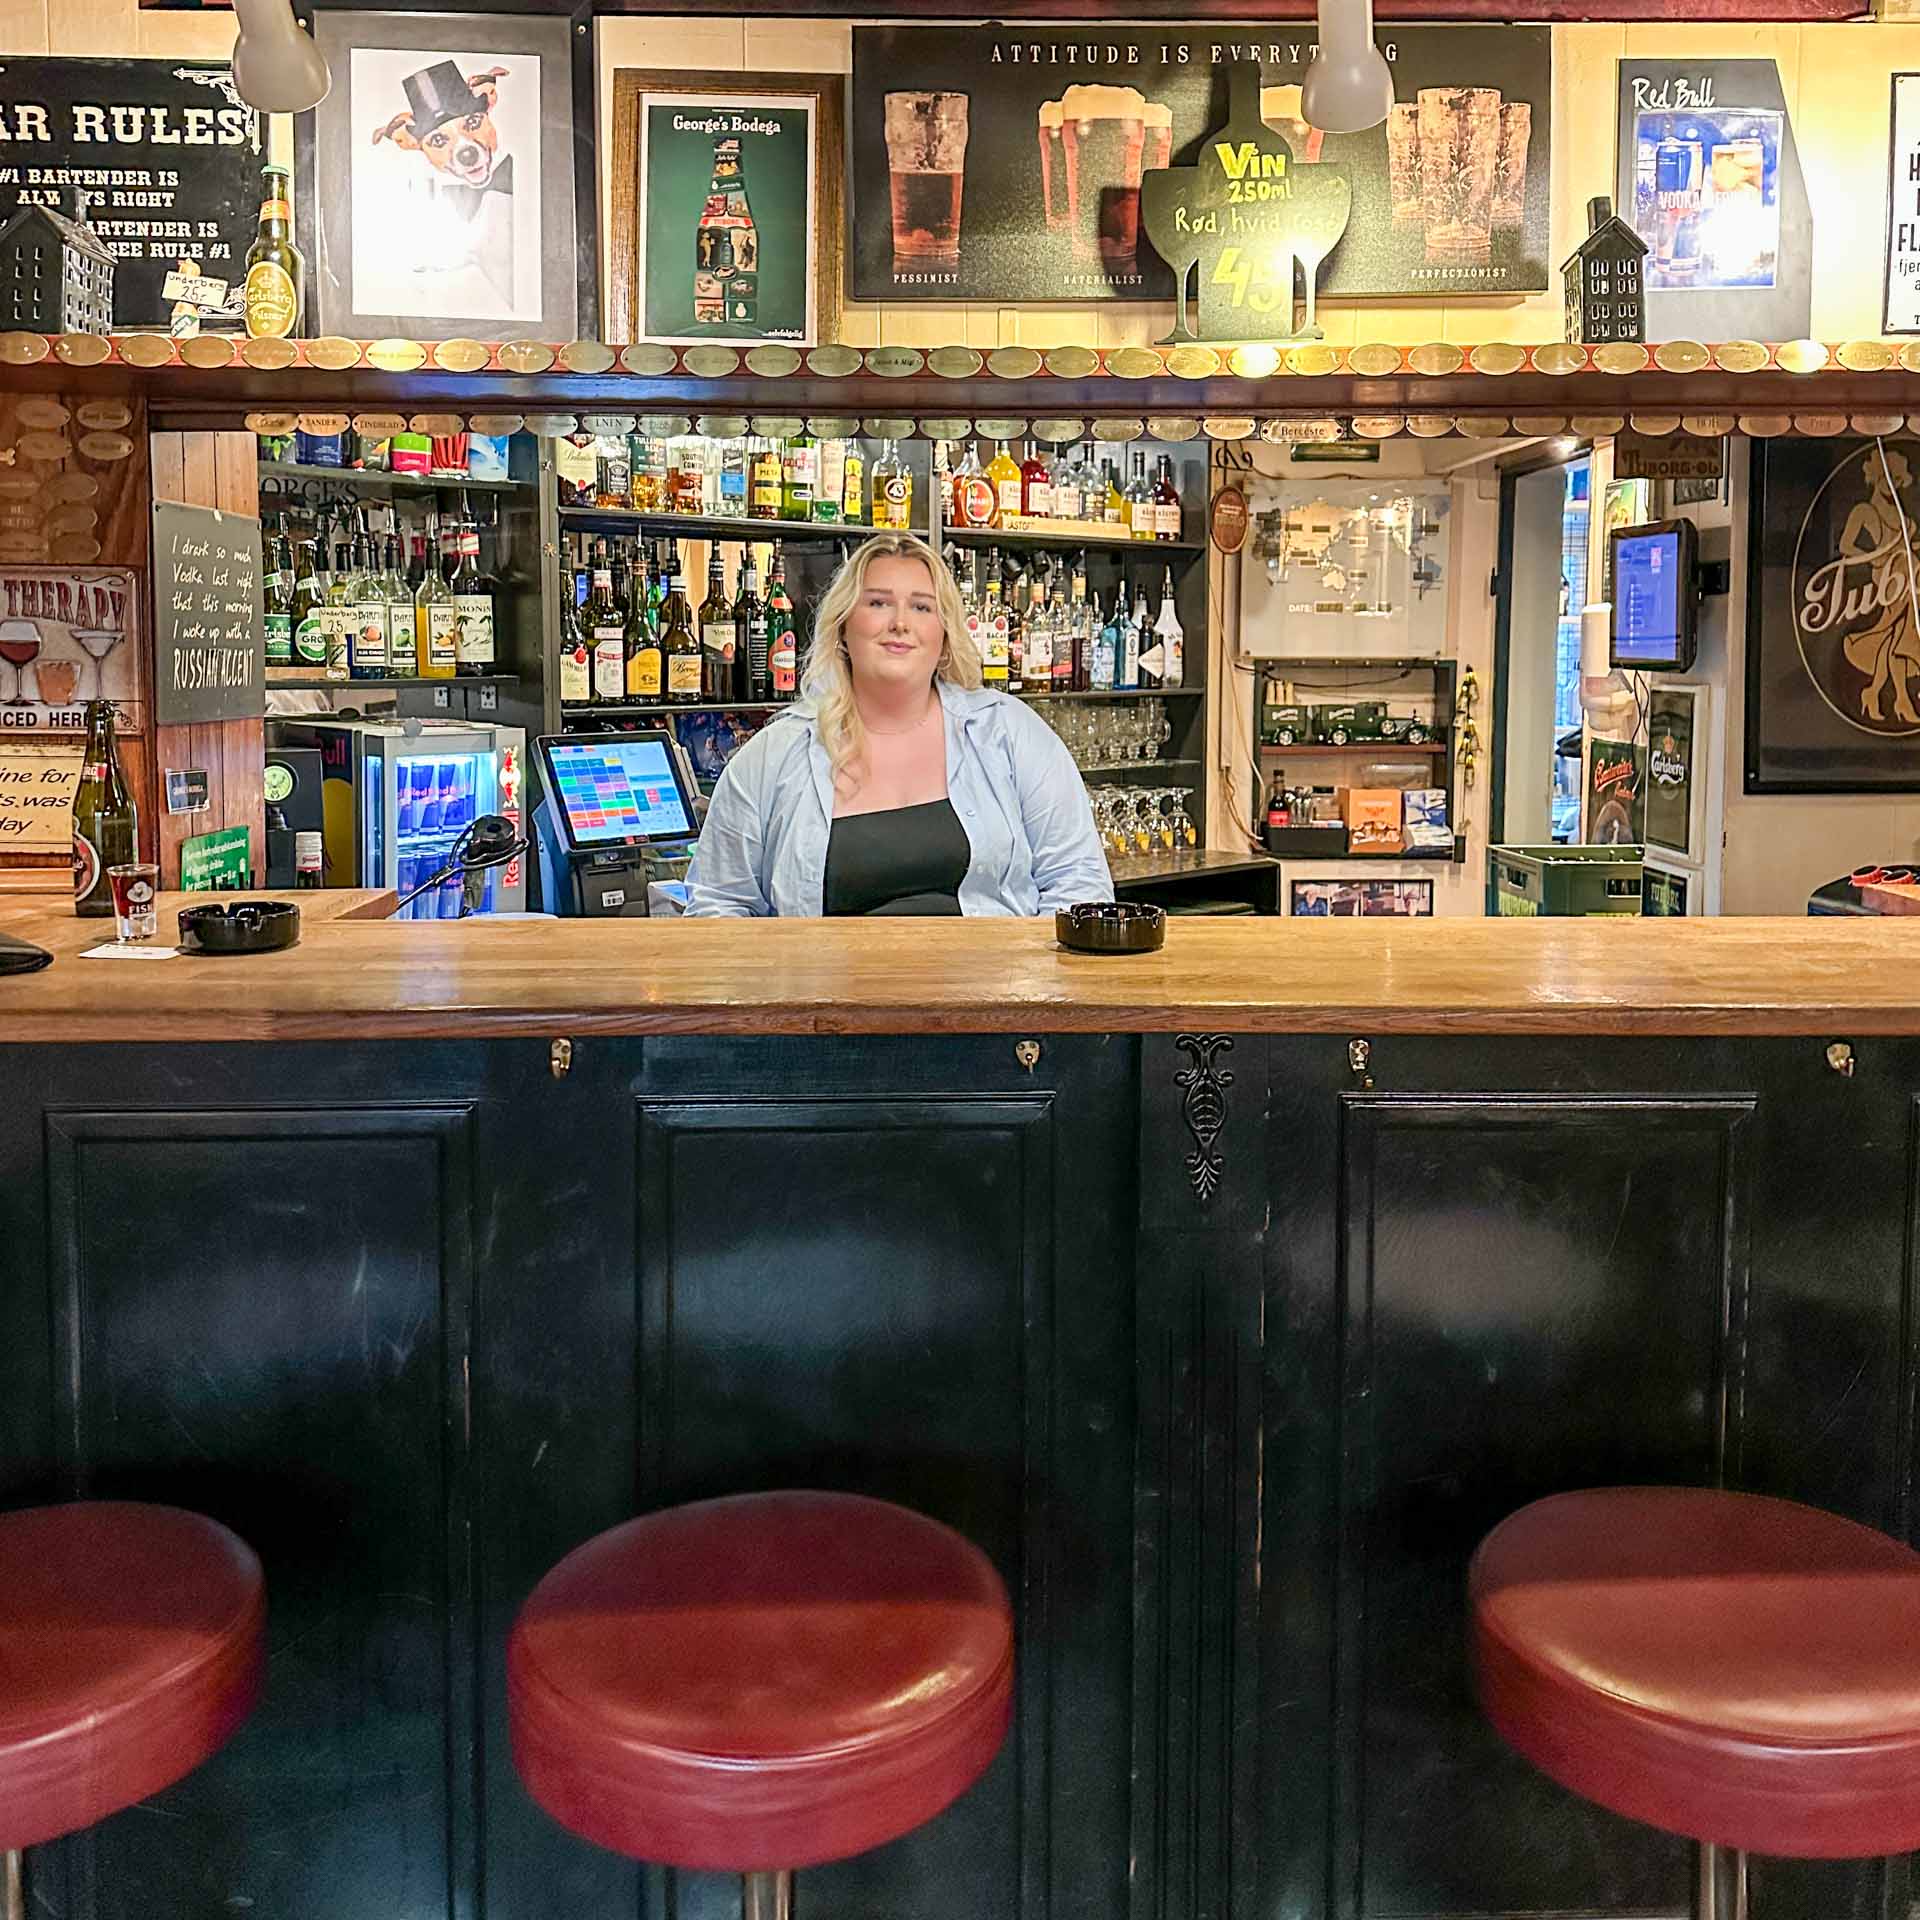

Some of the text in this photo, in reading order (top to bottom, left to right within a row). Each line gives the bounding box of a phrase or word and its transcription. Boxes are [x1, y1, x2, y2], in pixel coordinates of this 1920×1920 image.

[991, 43, 1398, 64] ATTITUDE IS EVERYTG
[1631, 77, 1716, 109] Red Bull
[0, 104, 246, 145] R RULES
[673, 115, 781, 136] George's Bodega
[28, 168, 152, 186] BARTENDER
[158, 170, 179, 186] IS
[112, 191, 175, 208] RIGHT
[85, 220, 219, 238] ARTENDER IS
[149, 242, 204, 259] RULE
[209, 243, 231, 259] #1
[893, 273, 960, 284] PESSIMIST
[1063, 274, 1144, 285] MATERIALIST
[1410, 267, 1508, 279] PERFECTIONIST
[172, 535, 178, 554] I
[216, 546, 226, 559] so
[233, 545, 252, 563] much
[172, 562, 204, 585] Vodka
[212, 567, 229, 587] last
[1800, 532, 1920, 632] Tub
[4, 579, 127, 631] THERAPY
[172, 591, 253, 624] that this morning
[172, 619, 178, 640] I
[182, 621, 206, 639] woke
[209, 626, 221, 647] up
[173, 647, 254, 691] RUSSIAN ACCENT
[40, 768, 76, 783] for
[1651, 750, 1685, 783] Carlsberg
[23, 796, 71, 807] was
